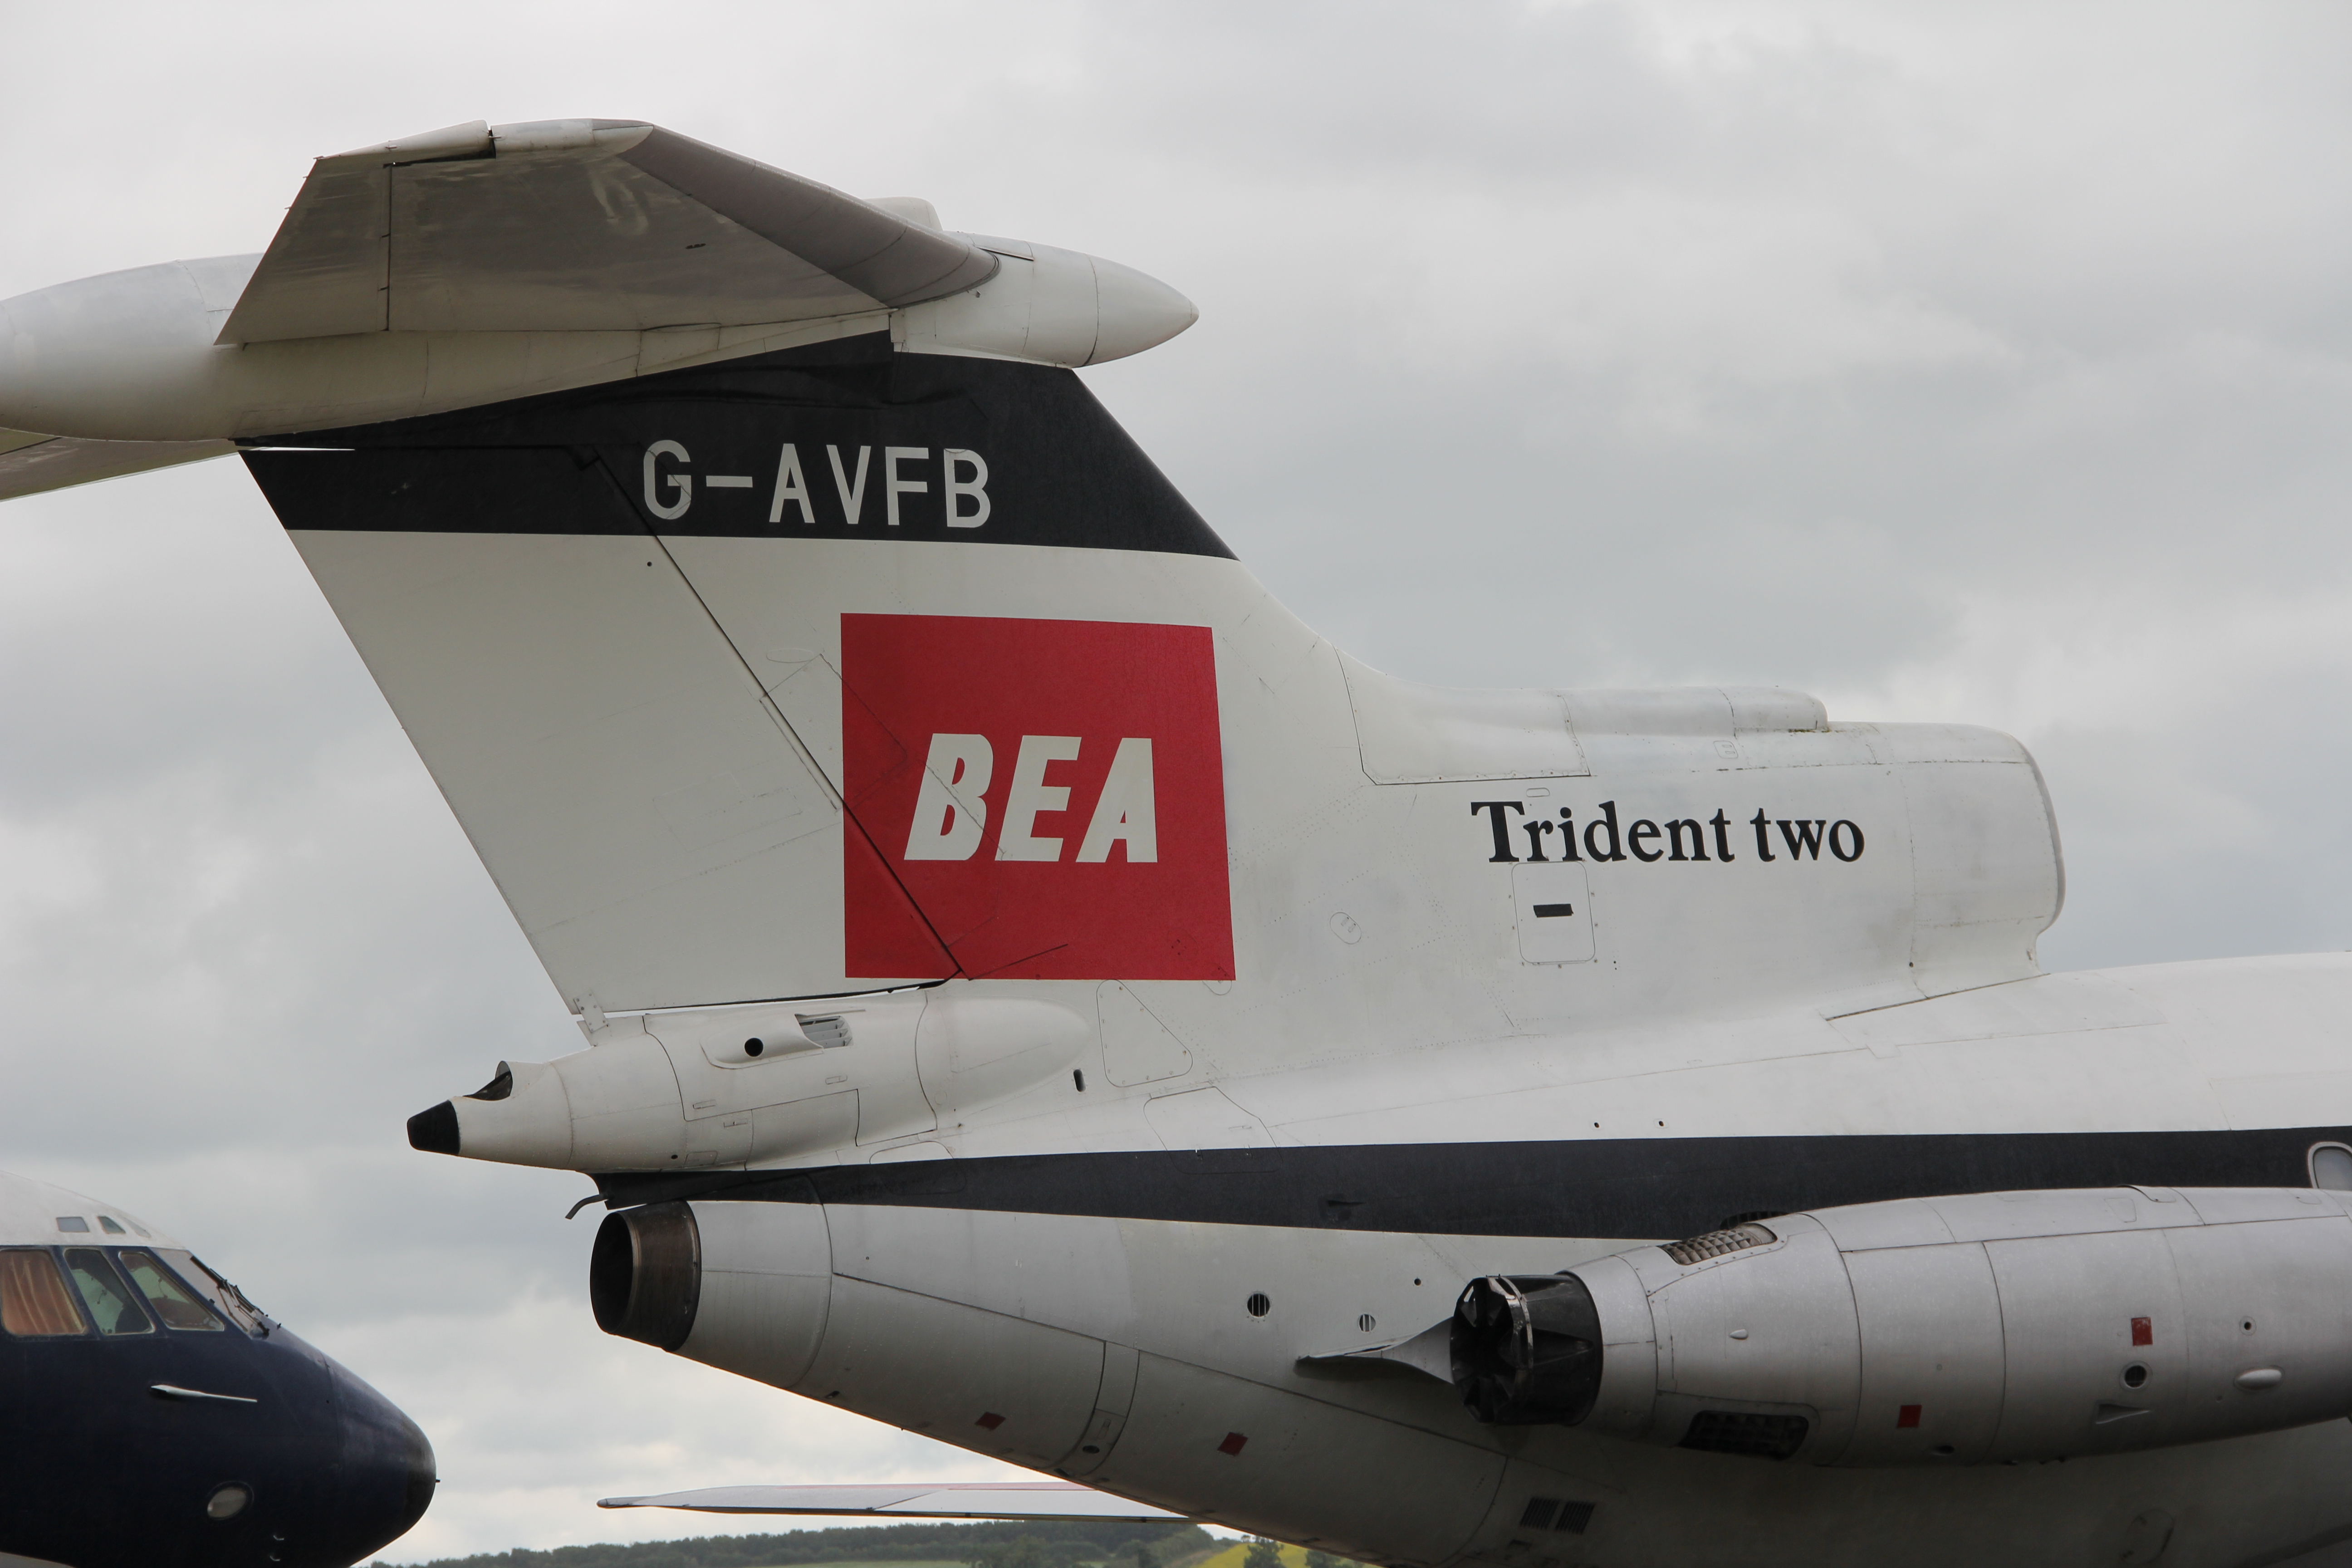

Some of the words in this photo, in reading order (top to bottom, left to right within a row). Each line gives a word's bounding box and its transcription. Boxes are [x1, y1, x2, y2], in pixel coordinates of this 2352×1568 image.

[643, 440, 991, 528] G-AVFB
[904, 733, 1158, 863] BEA
[1470, 800, 1735, 863] Trident
[1750, 808, 1865, 862] two
